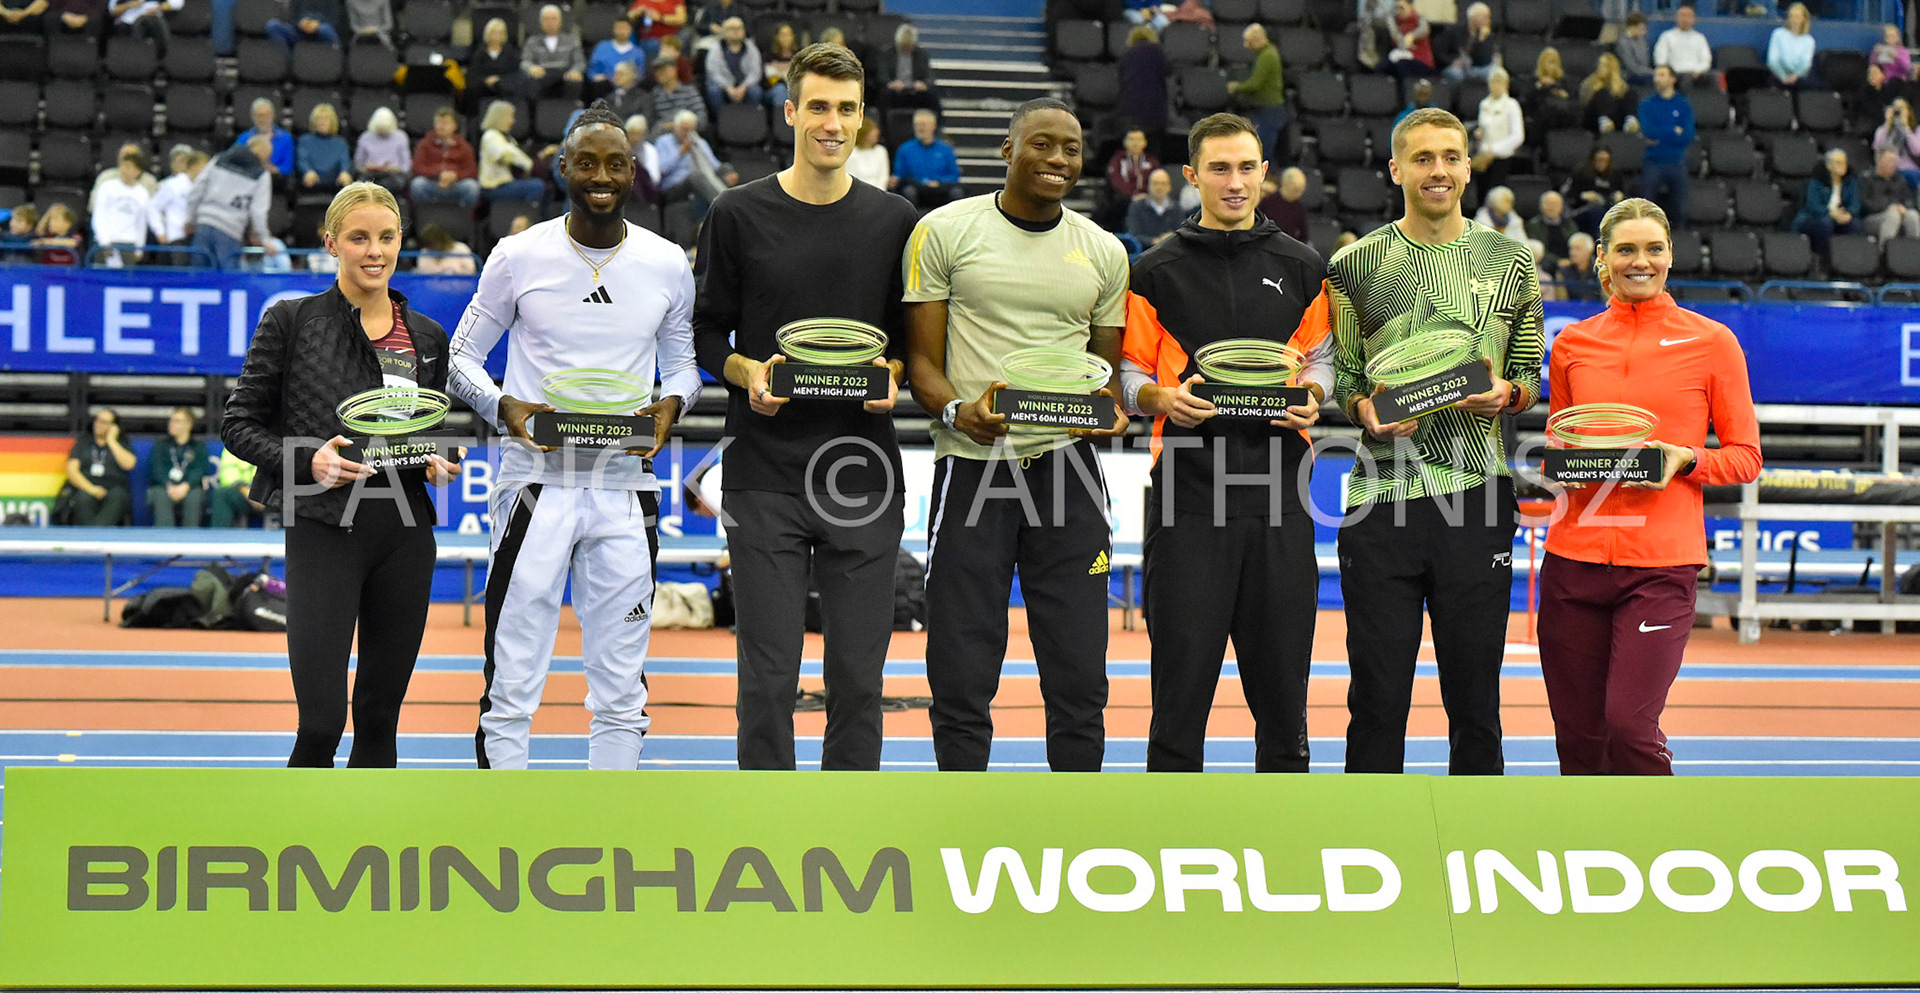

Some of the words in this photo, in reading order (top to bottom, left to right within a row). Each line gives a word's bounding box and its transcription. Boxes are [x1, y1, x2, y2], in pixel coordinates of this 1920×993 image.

[393, 358, 412, 369] TOUR
[794, 375, 841, 386] WINNER
[842, 377, 868, 387] 2023
[793, 387, 819, 395] MEN'S
[821, 387, 843, 396] HIGH
[844, 388, 868, 397] JUMP
[1395, 385, 1442, 407] WINNER
[1442, 376, 1468, 391] 2023
[1212, 395, 1259, 406] WINNER
[1261, 397, 1286, 407] 2023
[1408, 399, 1435, 414] MEN'S
[1435, 390, 1462, 405] 1500M
[1018, 401, 1065, 413] WINNER
[1067, 404, 1093, 415] 2023
[1238, 408, 1263, 416] LONG
[1010, 412, 1037, 421] MEN'S
[1039, 414, 1057, 423] 60M
[1059, 415, 1099, 426] HURDLES
[556, 423, 604, 435] WINNER
[606, 426, 633, 436] 2023
[568, 436, 595, 445] MEN'S
[596, 437, 620, 446] 400M
[361, 445, 409, 458] WINNER
[411, 442, 437, 453] 2023
[366, 457, 408, 468] WOMEN'S
[1565, 459, 1612, 469] WINNER
[1614, 459, 1640, 469] 2023
[1556, 471, 1597, 479] WOMEN'S
[1599, 471, 1621, 479] POLE
[1622, 470, 1649, 479] VAULT
[624, 613, 648, 623] adidas
[67, 845, 913, 913] BIRMINGHAM
[940, 847, 1402, 914] WORLD
[1446, 848, 1908, 915] INDOOR
